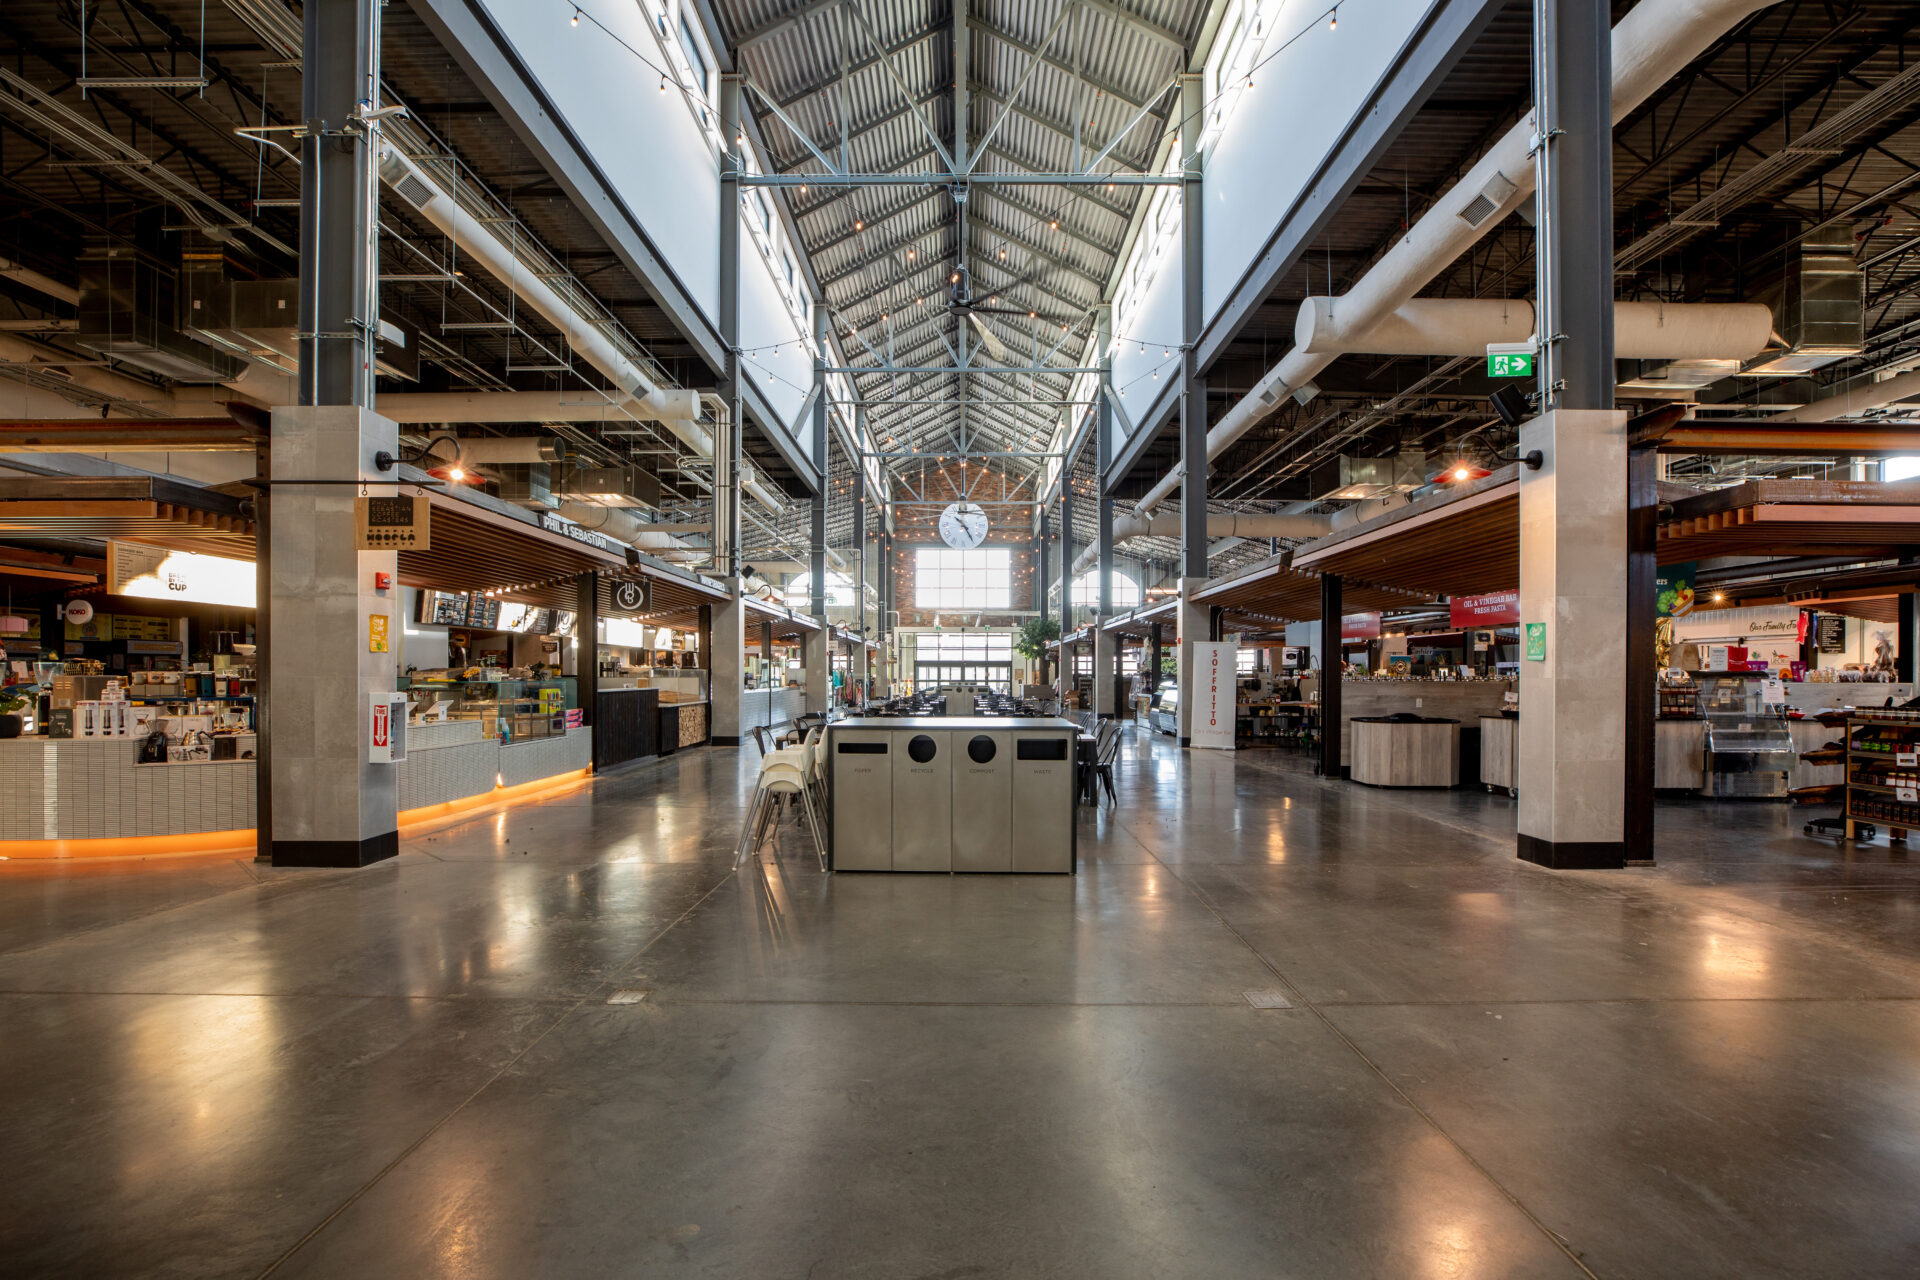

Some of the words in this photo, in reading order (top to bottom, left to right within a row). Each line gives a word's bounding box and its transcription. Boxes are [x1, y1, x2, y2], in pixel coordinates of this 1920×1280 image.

[543, 515, 562, 534] PHIL
[562, 523, 569, 536] &
[569, 526, 607, 549] SEBASTIAN
[169, 583, 187, 591] CUP
[1463, 600, 1473, 608] OIL
[1479, 595, 1505, 606] VINEGAR
[1474, 606, 1490, 614] FRESH
[1491, 604, 1506, 613] PASTA
[1750, 621, 1762, 632] Our
[1763, 620, 1786, 631] Family
[1786, 619, 1797, 630] Fa
[1210, 650, 1218, 726] SOFFRITTO
